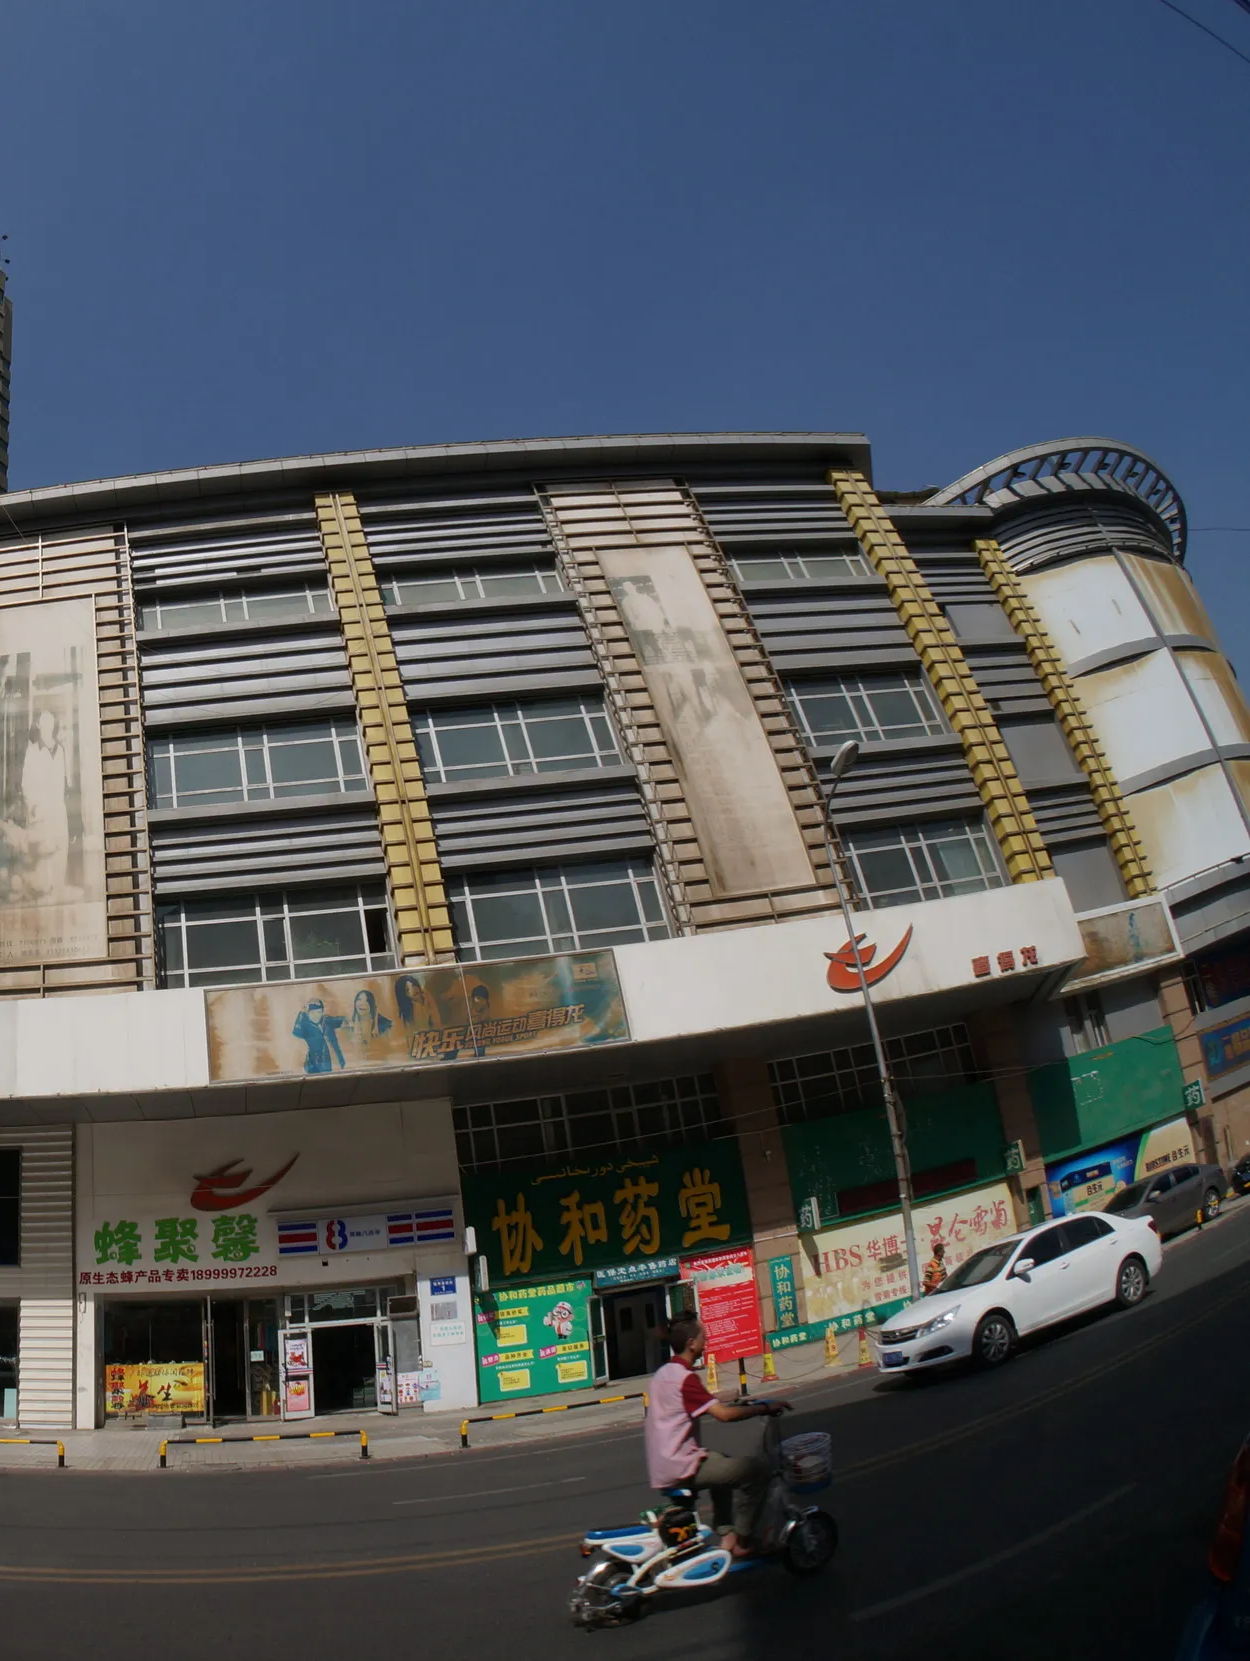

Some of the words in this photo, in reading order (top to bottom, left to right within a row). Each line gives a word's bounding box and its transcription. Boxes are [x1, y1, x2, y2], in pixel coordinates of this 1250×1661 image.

[1185, 1085, 1200, 1107] 药
[1006, 1150, 1021, 1170] 药
[492, 1167, 731, 1276] 协和药堂
[800, 1207, 812, 1229] 药
[94, 1214, 260, 1266] 蜂聚馨
[597, 1258, 677, 1279] 医保定点零售药店
[814, 1244, 864, 1278] HBS
[499, 1282, 575, 1302] 协和药堂药品超市
[773, 1264, 795, 1327] 协和药堂
[827, 1311, 878, 1333] 协和药堂
[772, 1332, 808, 1348] 协和药堂
